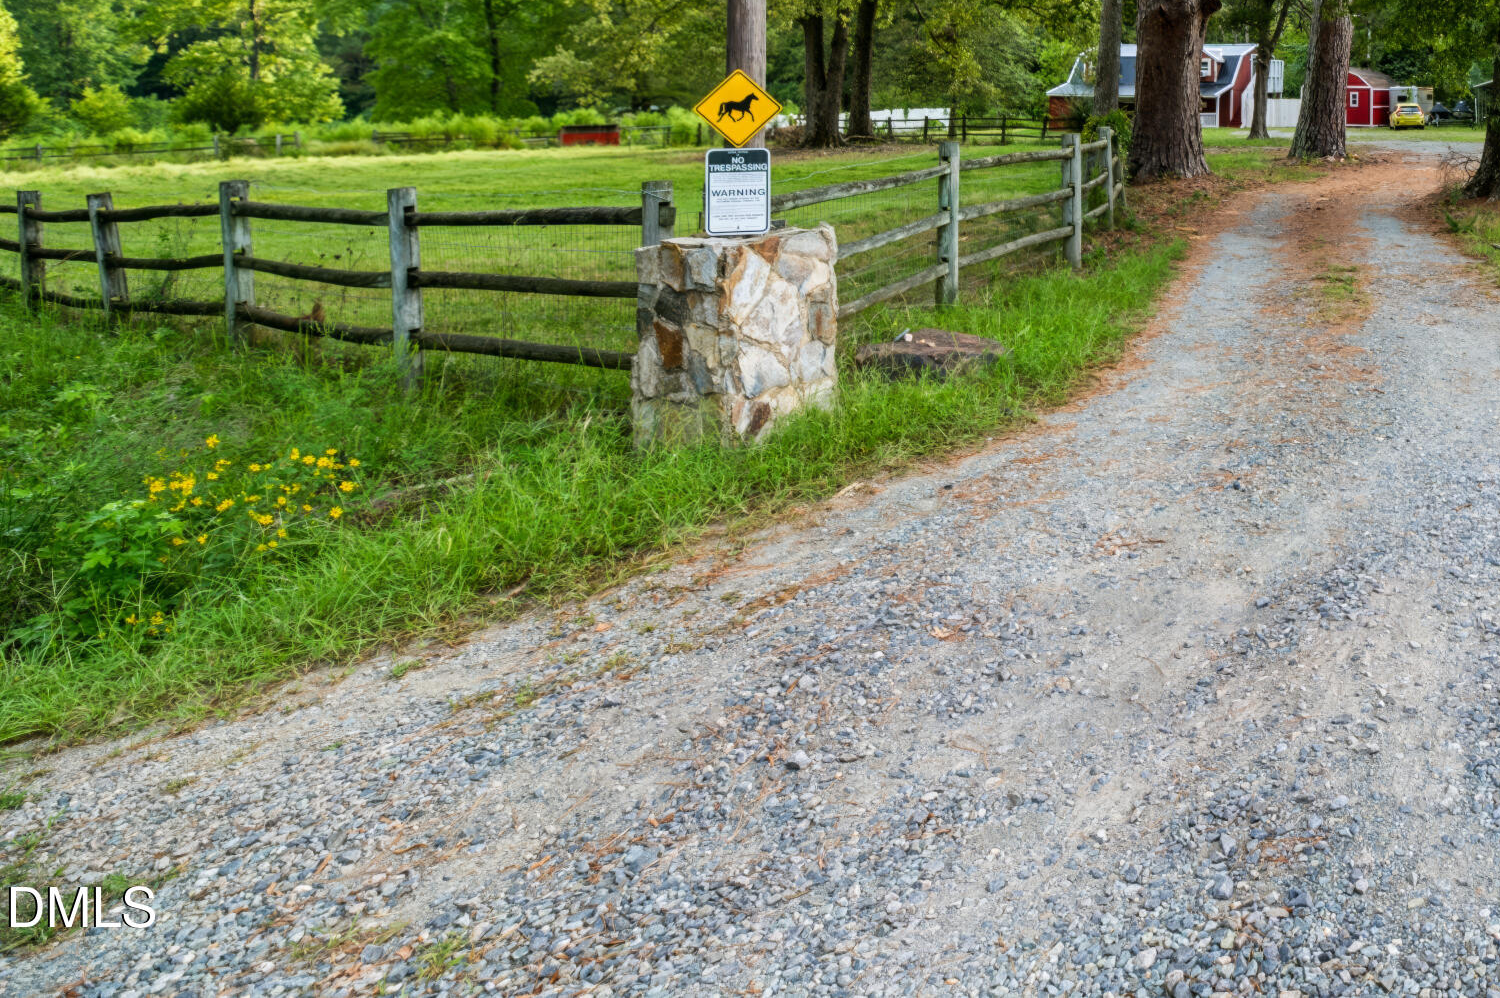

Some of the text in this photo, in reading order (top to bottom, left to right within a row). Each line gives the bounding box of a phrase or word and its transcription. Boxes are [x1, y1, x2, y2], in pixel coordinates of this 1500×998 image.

[731, 156, 745, 164] NO
[709, 163, 768, 172] TRESPASSING
[711, 188, 766, 197] WARNING
